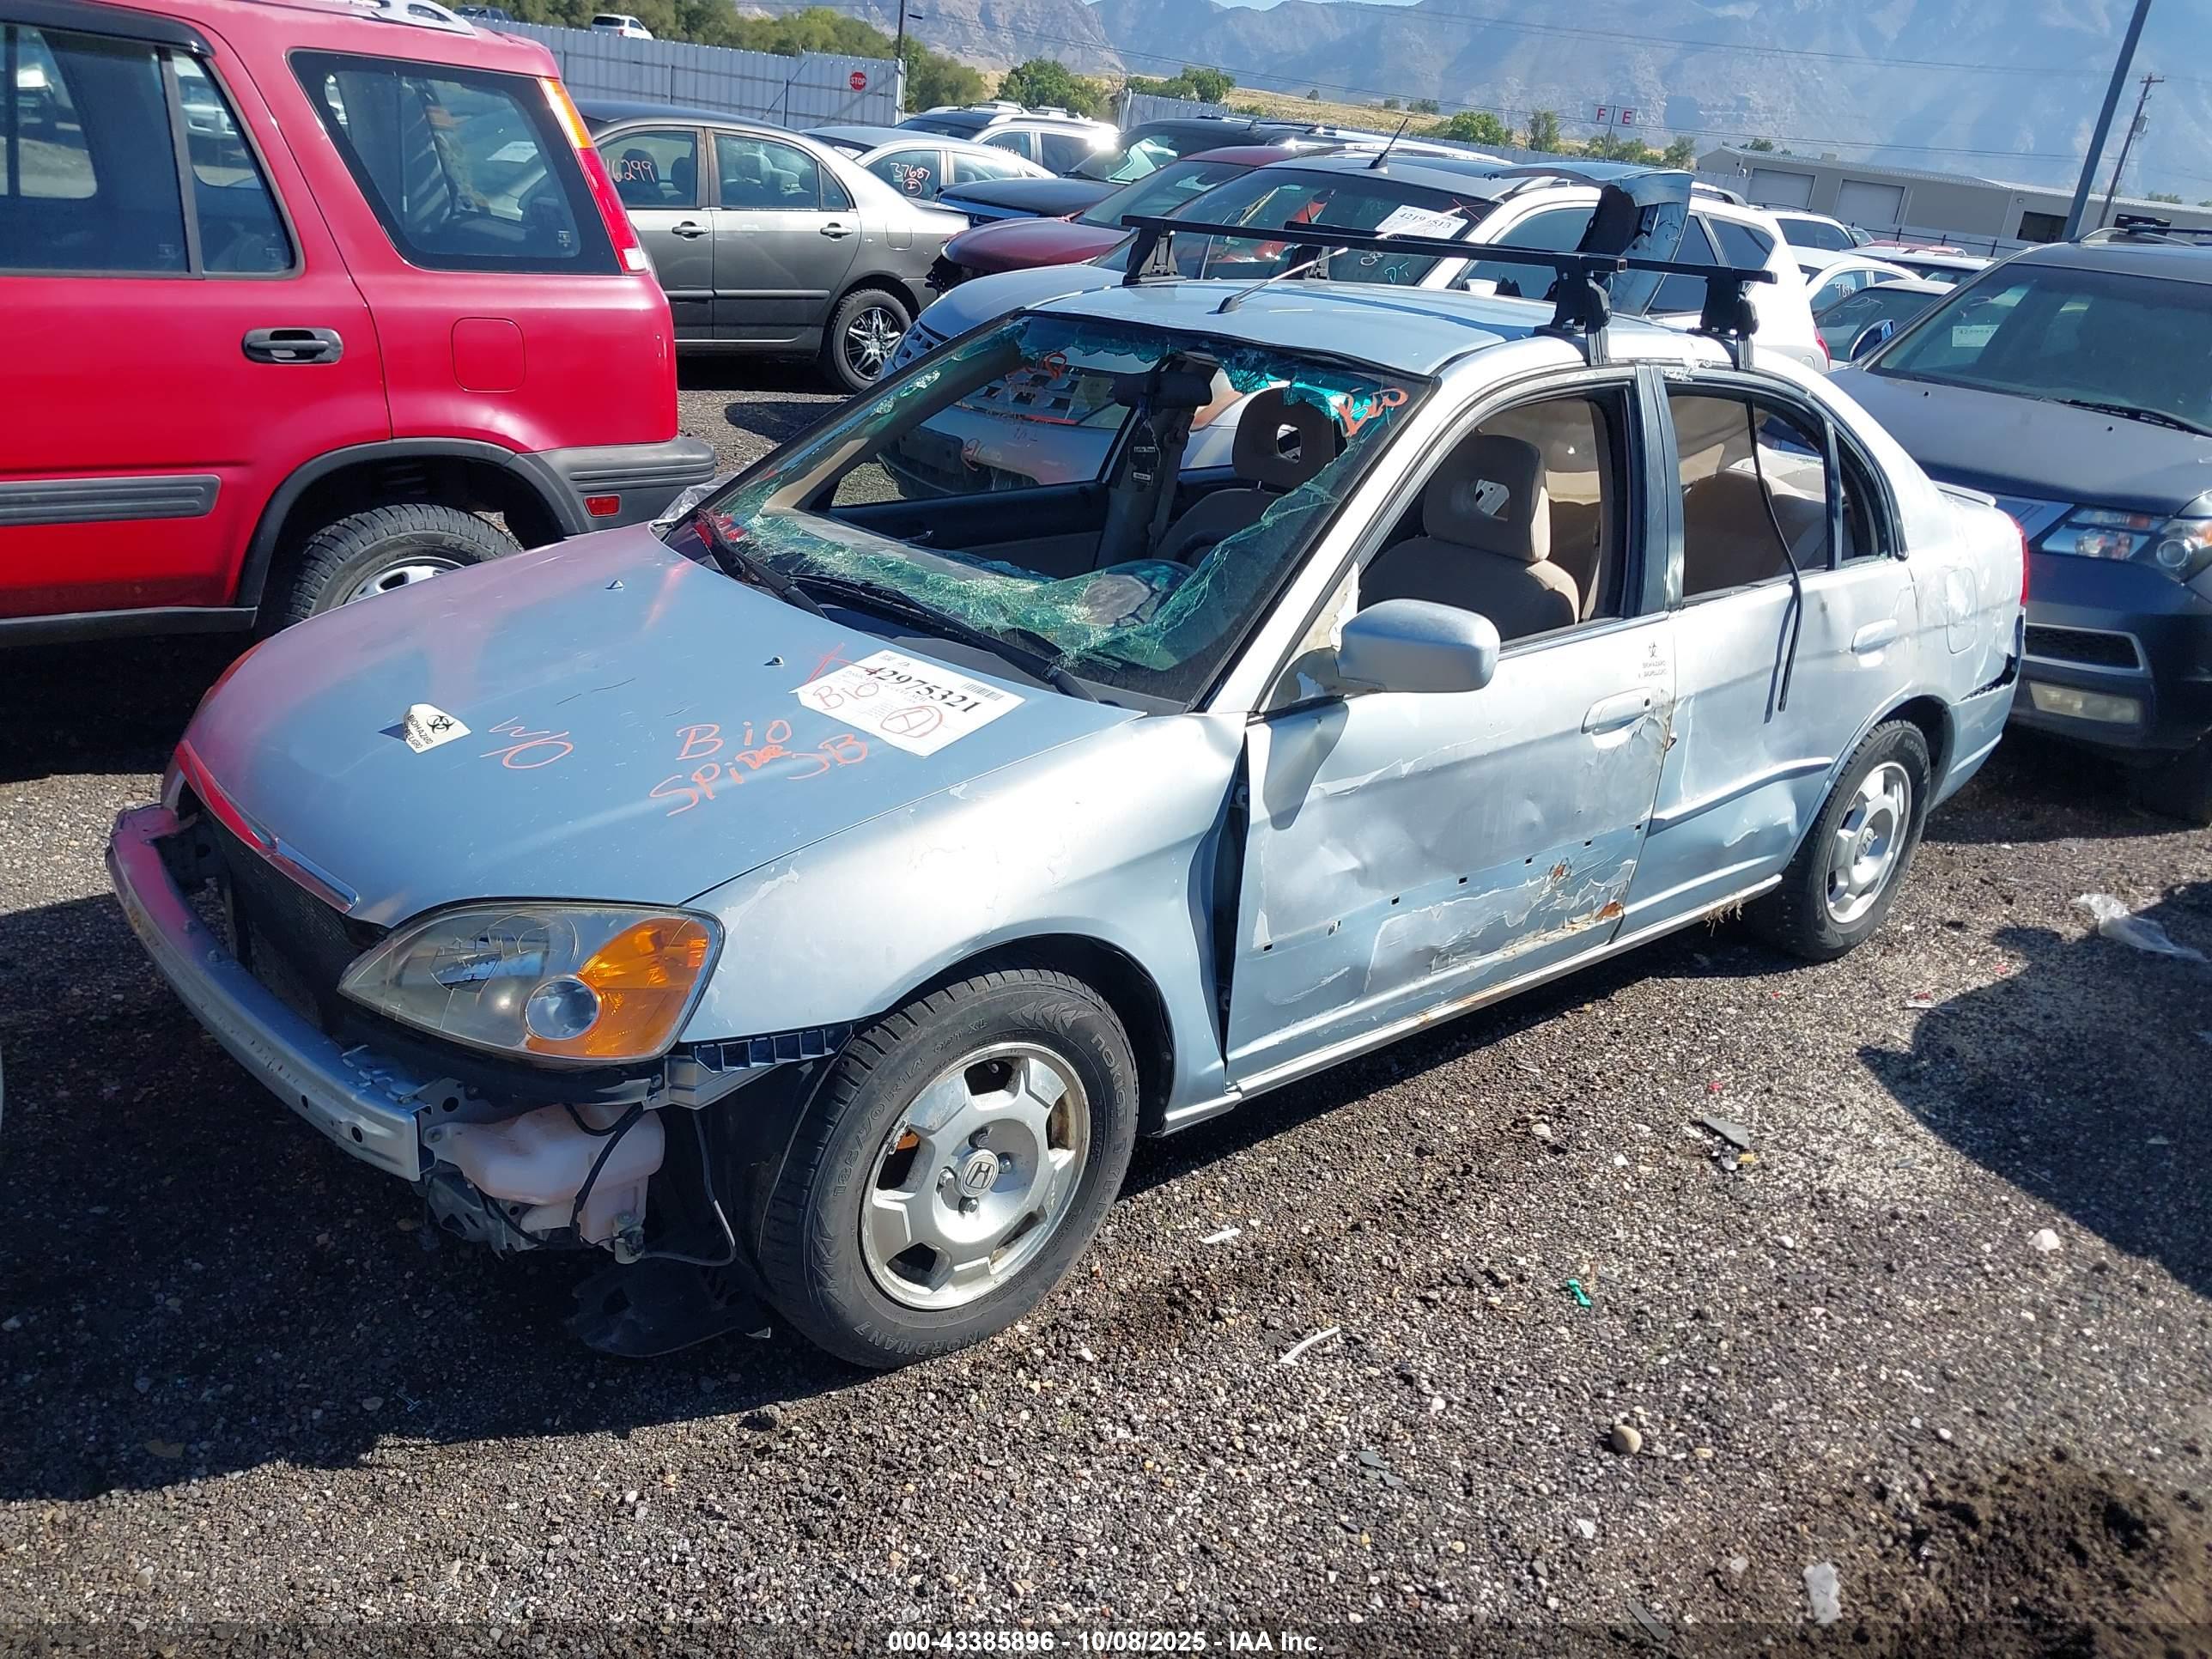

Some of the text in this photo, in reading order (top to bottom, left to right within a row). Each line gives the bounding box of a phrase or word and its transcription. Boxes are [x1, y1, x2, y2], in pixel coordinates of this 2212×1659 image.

[850, 76, 866, 85] STOP
[1596, 107, 1607, 121] F
[1621, 111, 1632, 125] E
[1399, 211, 1452, 228] 4219513
[865, 666, 981, 714] 42975321
[407, 714, 434, 745] BIOHAZARD
[867, 1330, 981, 1356] NORDMAN
